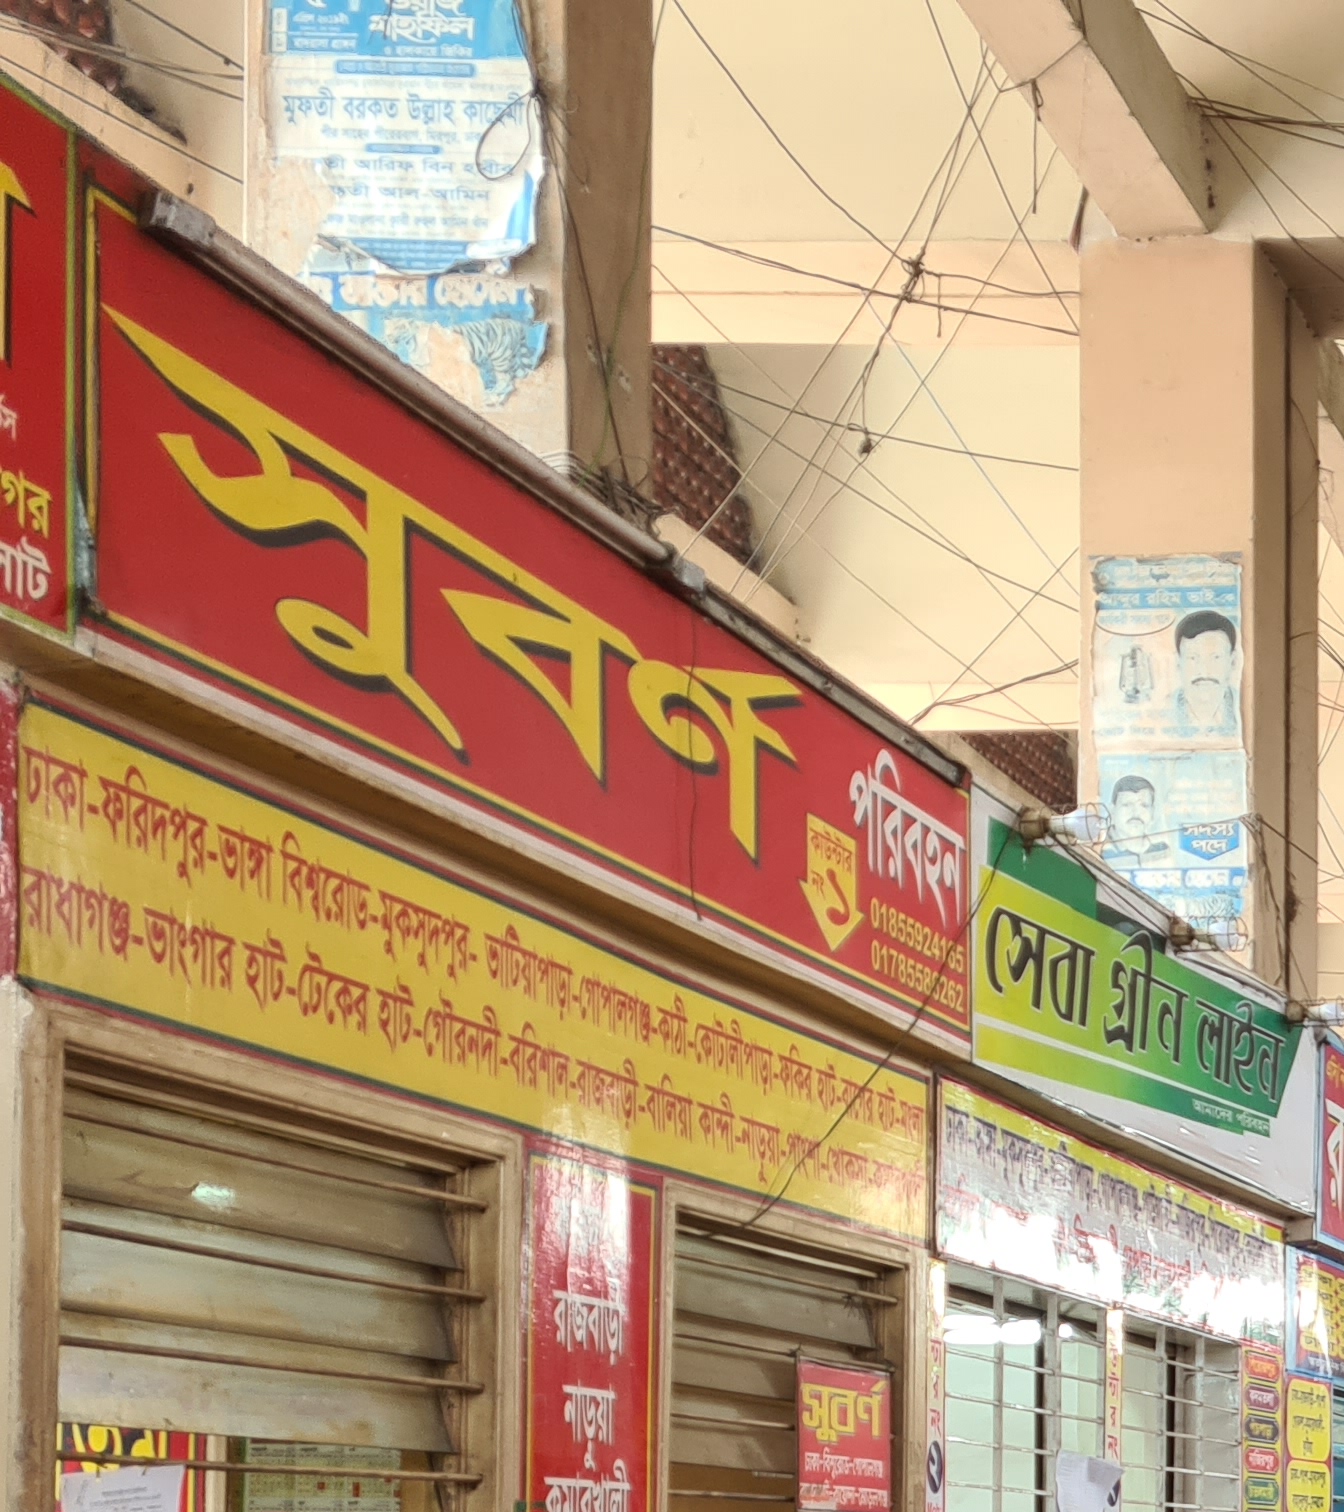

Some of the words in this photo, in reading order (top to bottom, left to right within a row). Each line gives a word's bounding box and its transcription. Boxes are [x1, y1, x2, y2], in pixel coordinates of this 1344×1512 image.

[343, 97, 399, 119] বরকত
[849, 747, 967, 926] পরিবহন
[1190, 837, 1228, 855] পদে
[985, 906, 1096, 1029] সেবা
[1102, 930, 1189, 1065] গ্রীন
[1194, 1000, 1287, 1104] লাইন
[800, 1380, 889, 1443] সুবর্ণ
